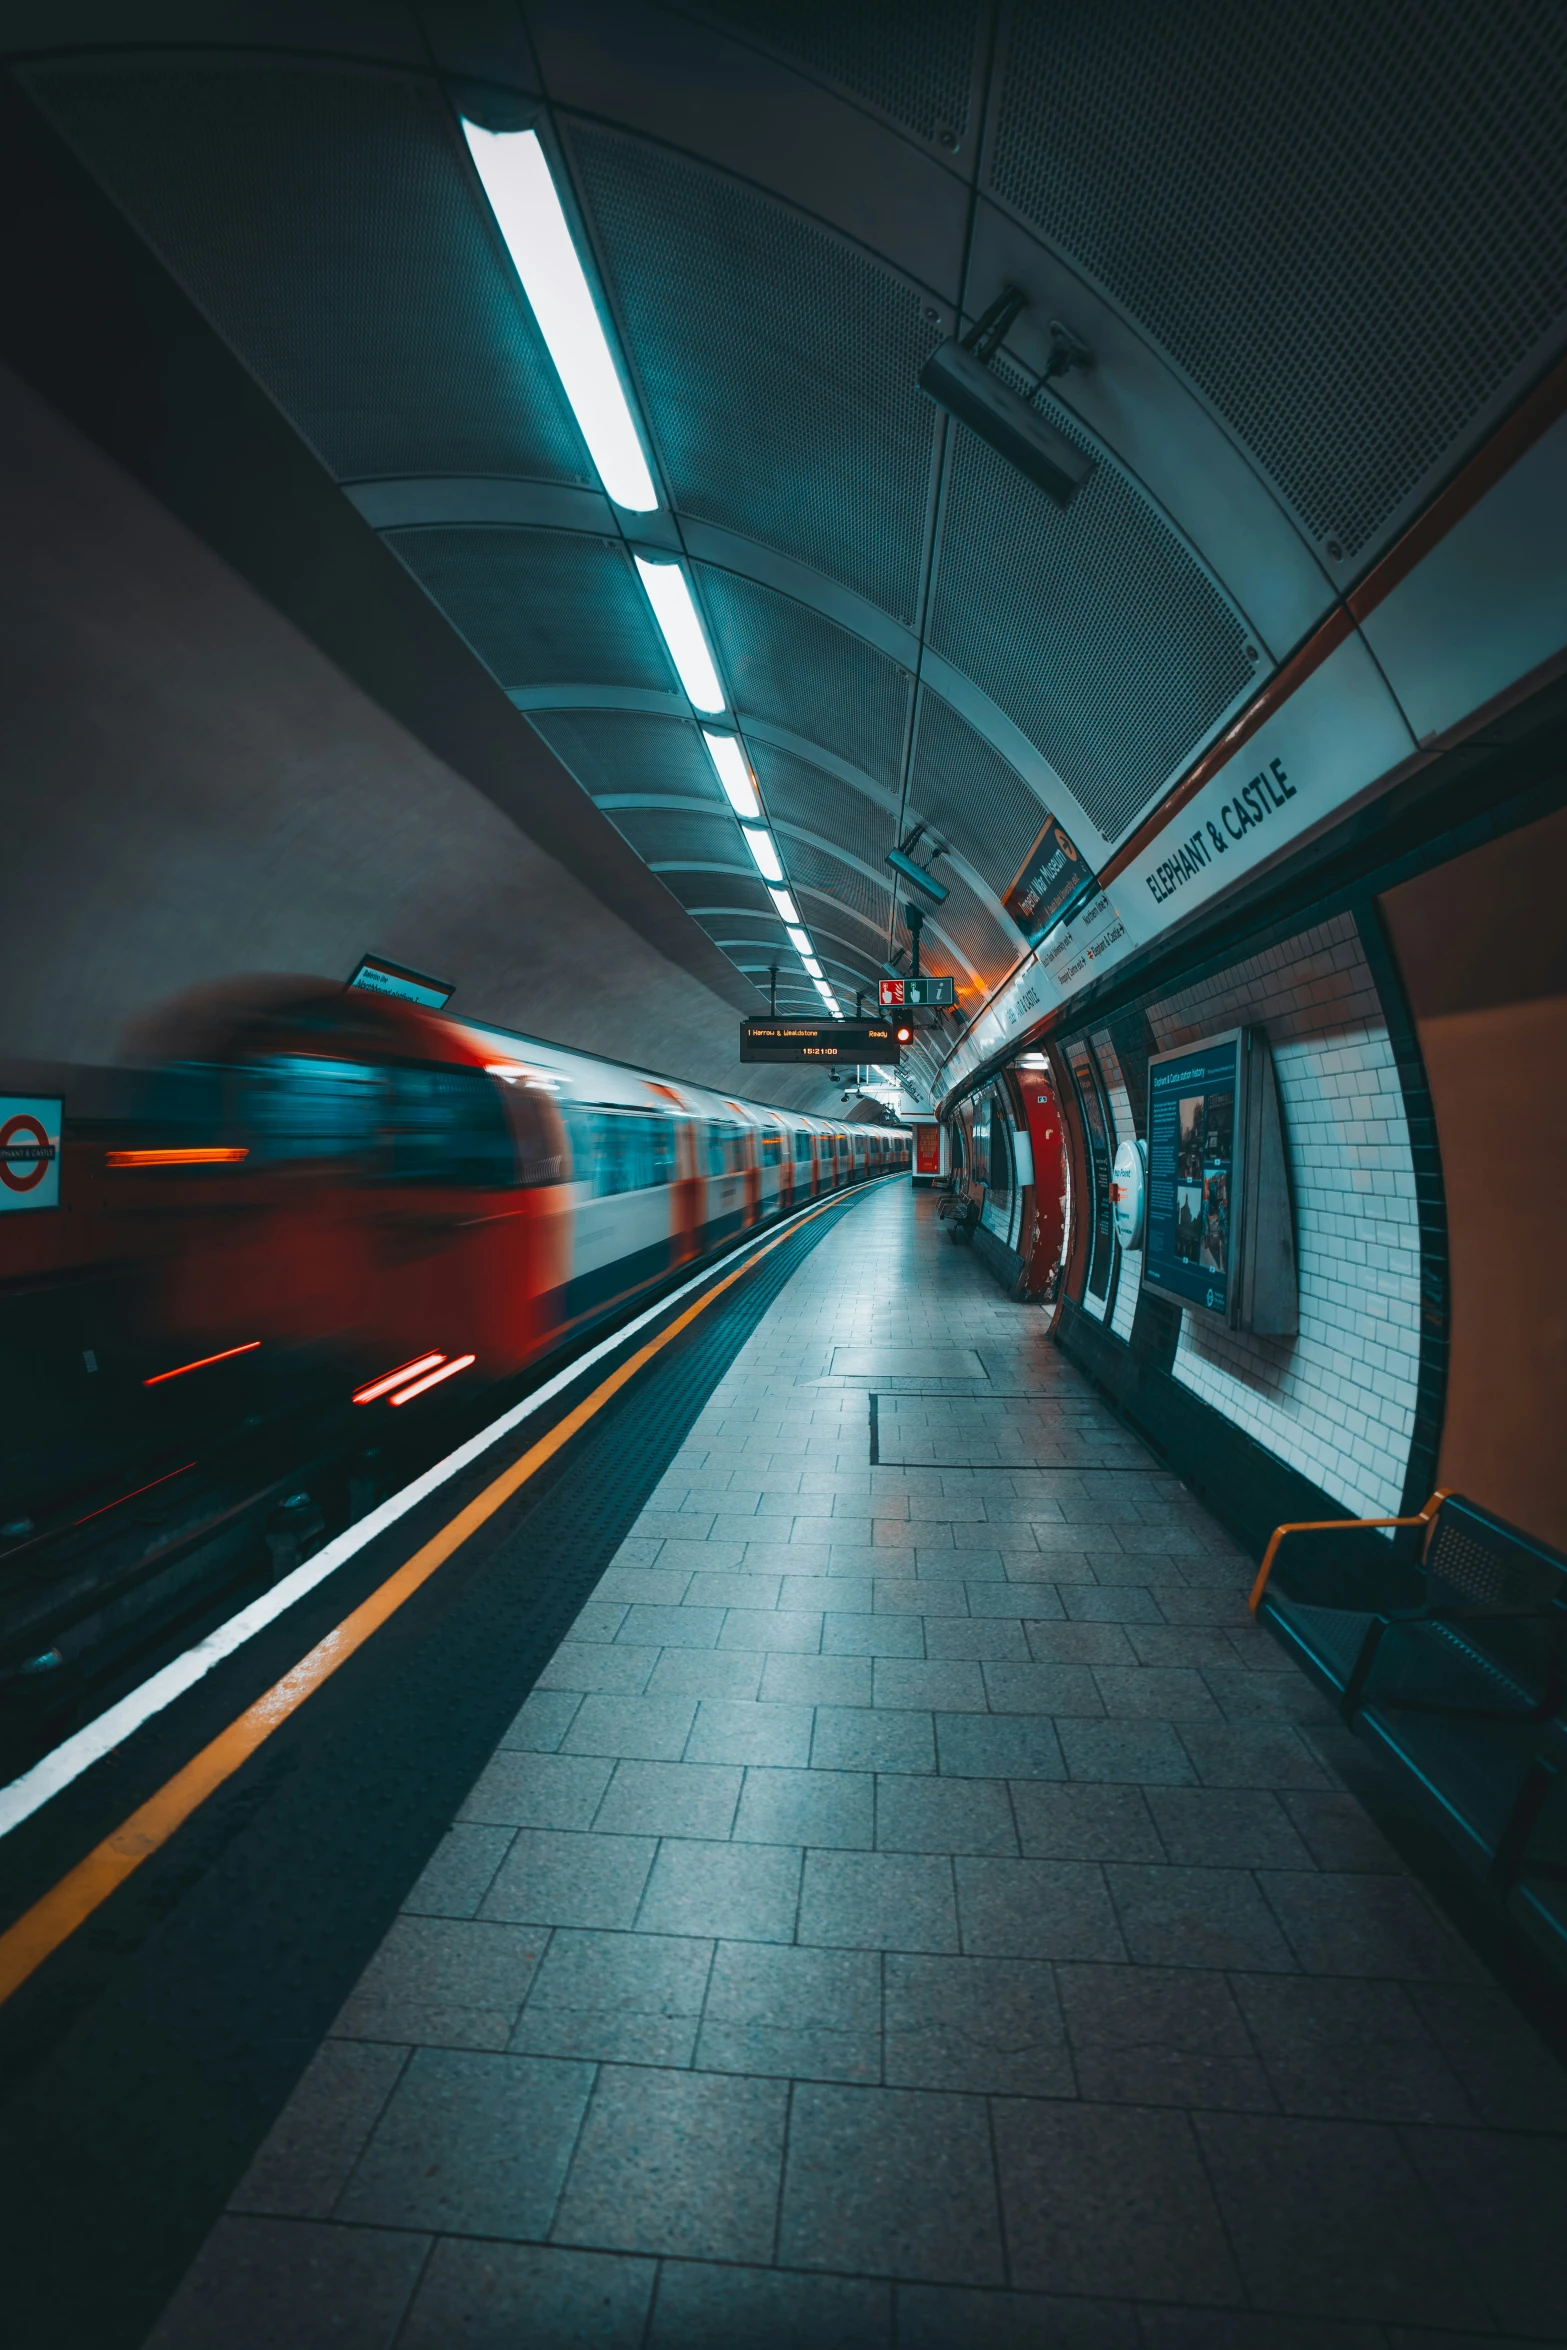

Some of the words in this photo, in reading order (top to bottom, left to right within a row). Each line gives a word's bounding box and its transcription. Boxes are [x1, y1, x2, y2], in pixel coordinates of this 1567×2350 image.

[1145, 830, 1212, 904] ELEPHANT
[1206, 820, 1228, 853] &
[1221, 757, 1297, 840] CASTLE
[1039, 848, 1067, 884] Museum
[1032, 876, 1048, 895] War
[1018, 884, 1040, 917] Imperial
[1082, 906, 1100, 926] Northern
[1094, 900, 1106, 913] line
[1091, 941, 1106, 957] Elephant
[1107, 929, 1122, 943] Castle
[868, 1030, 888, 1038] Ready
[1191, 1067, 1205, 1079] history
[31, 1148, 53, 1157] CASTLE
